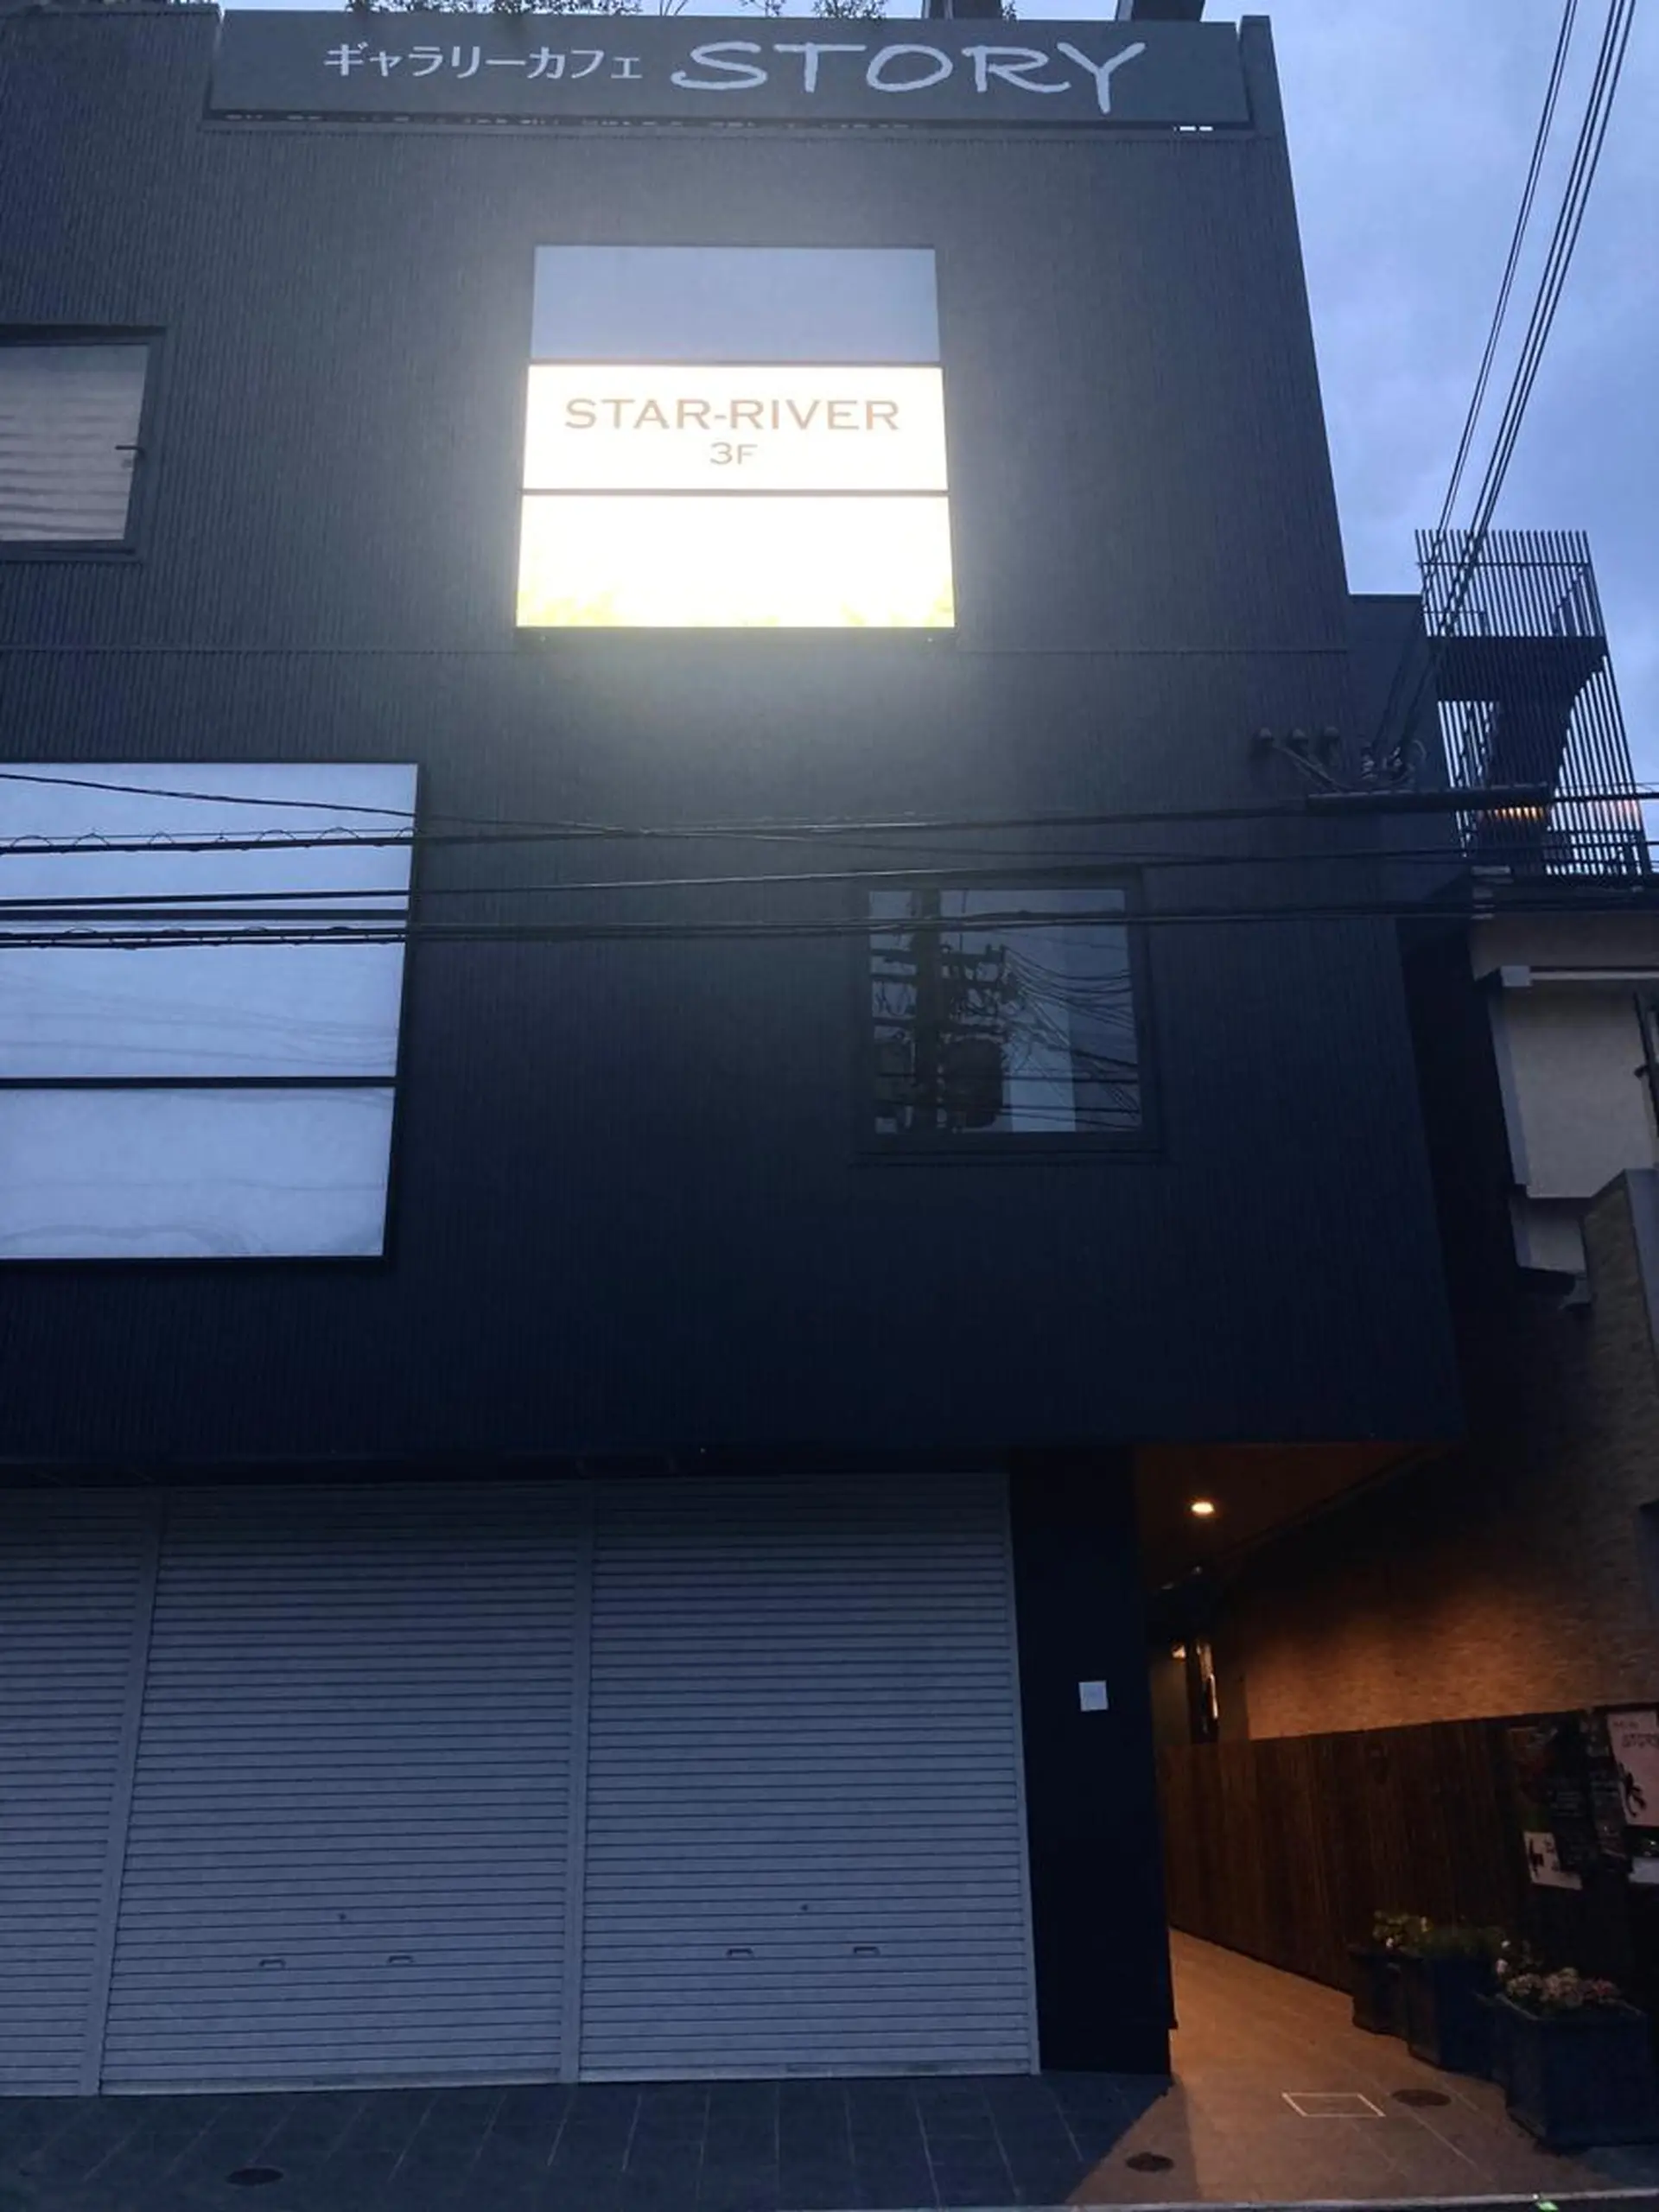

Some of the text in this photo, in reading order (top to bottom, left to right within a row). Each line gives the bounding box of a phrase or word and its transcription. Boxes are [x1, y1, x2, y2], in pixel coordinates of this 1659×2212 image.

[324, 41, 1145, 113] ギャラリーカフェ STORY
[564, 398, 899, 430] STAR-RIVER
[709, 442, 758, 465] 3F
